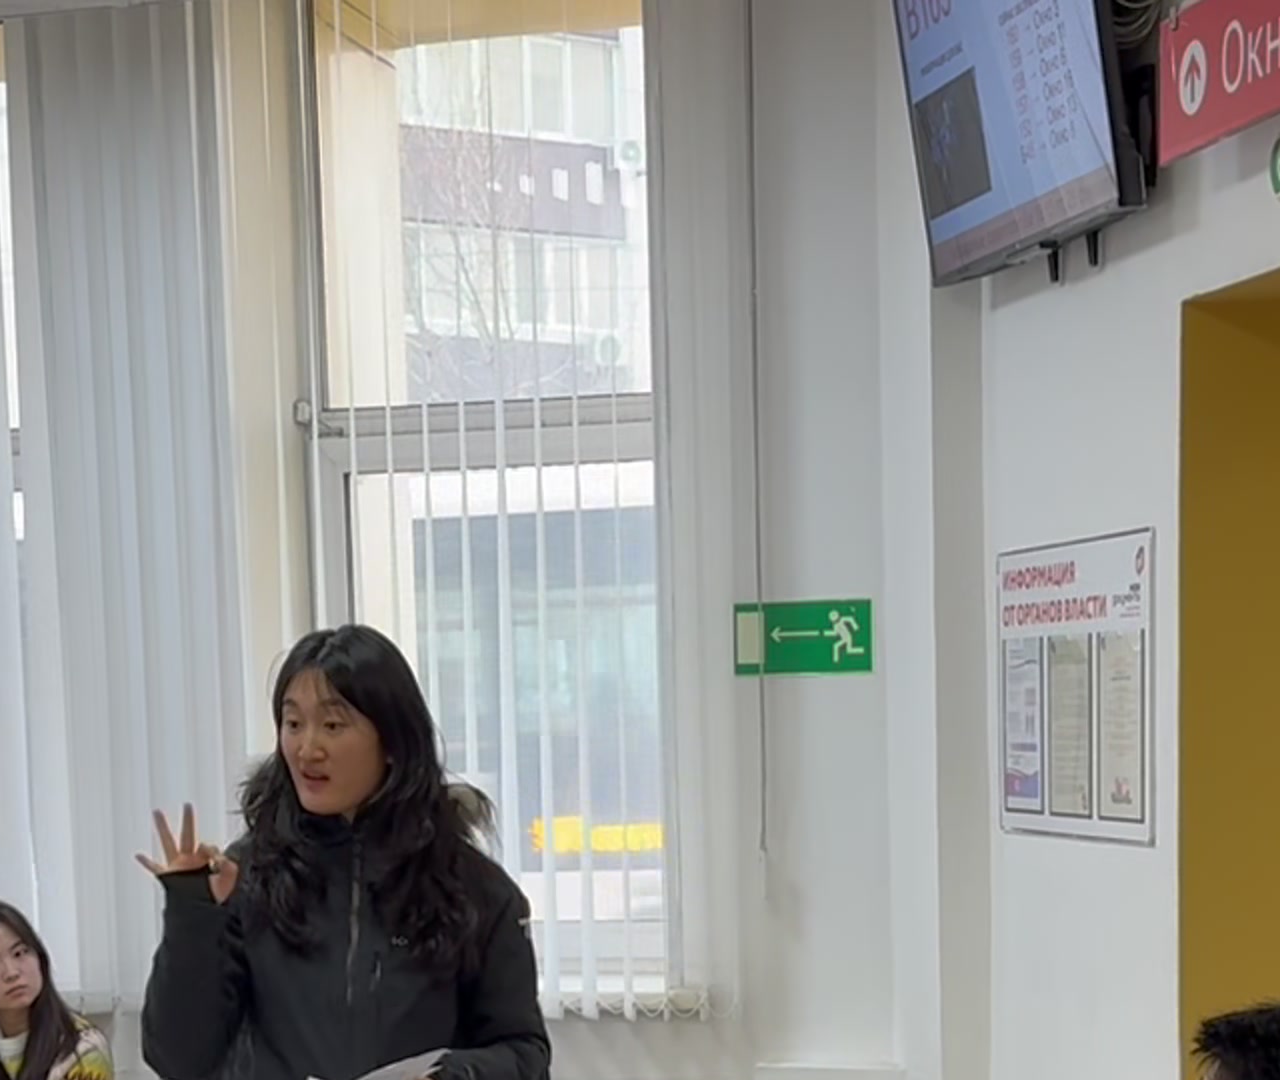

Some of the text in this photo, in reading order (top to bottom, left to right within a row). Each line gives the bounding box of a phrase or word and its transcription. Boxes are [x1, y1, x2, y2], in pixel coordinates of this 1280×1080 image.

[1002, 560, 1075, 592] ИНФОРМАЦИЯ
[1003, 603, 1016, 628] ОТ
[1017, 598, 1063, 626] ОРГАНОВ
[1064, 594, 1108, 622] ВЛАСТИ
